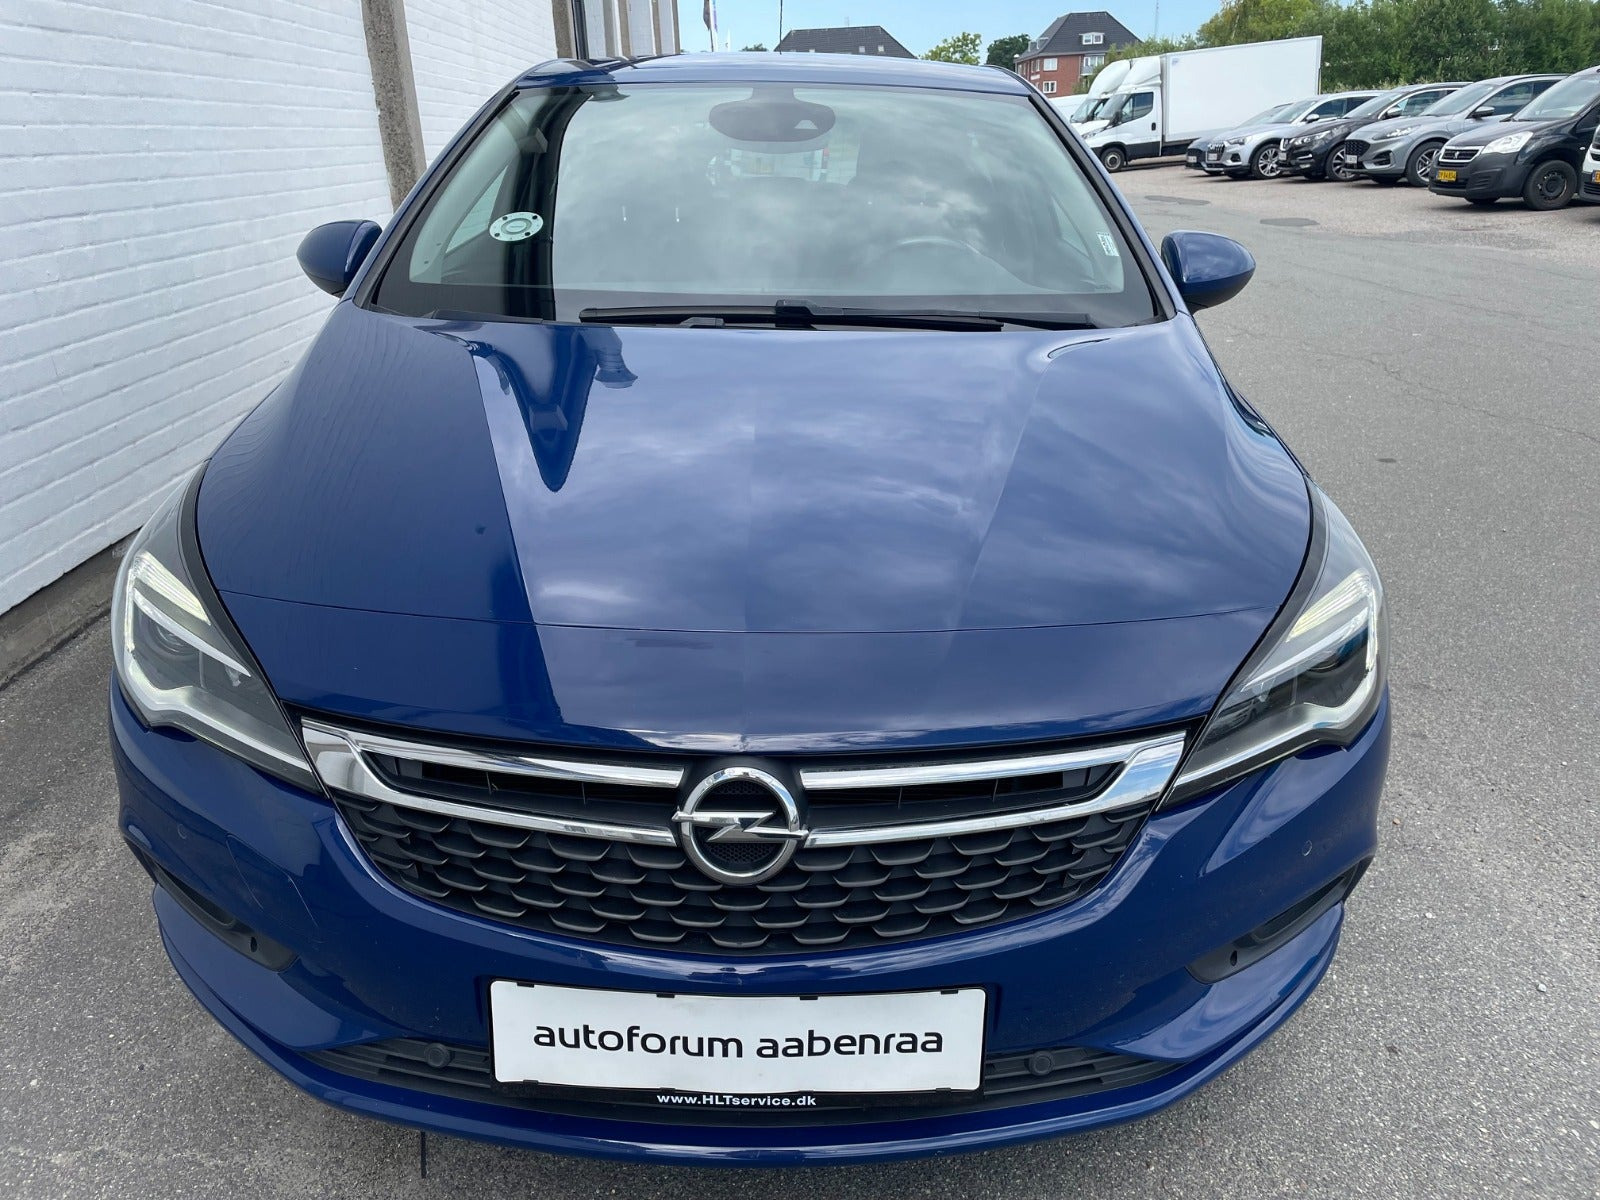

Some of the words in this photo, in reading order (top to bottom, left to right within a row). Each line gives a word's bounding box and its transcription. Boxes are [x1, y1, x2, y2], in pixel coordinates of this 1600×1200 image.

[533, 1024, 743, 1058] autoforum
[756, 1029, 943, 1059] aabenraa
[656, 1094, 817, 1106] www.HLTservice.dk
